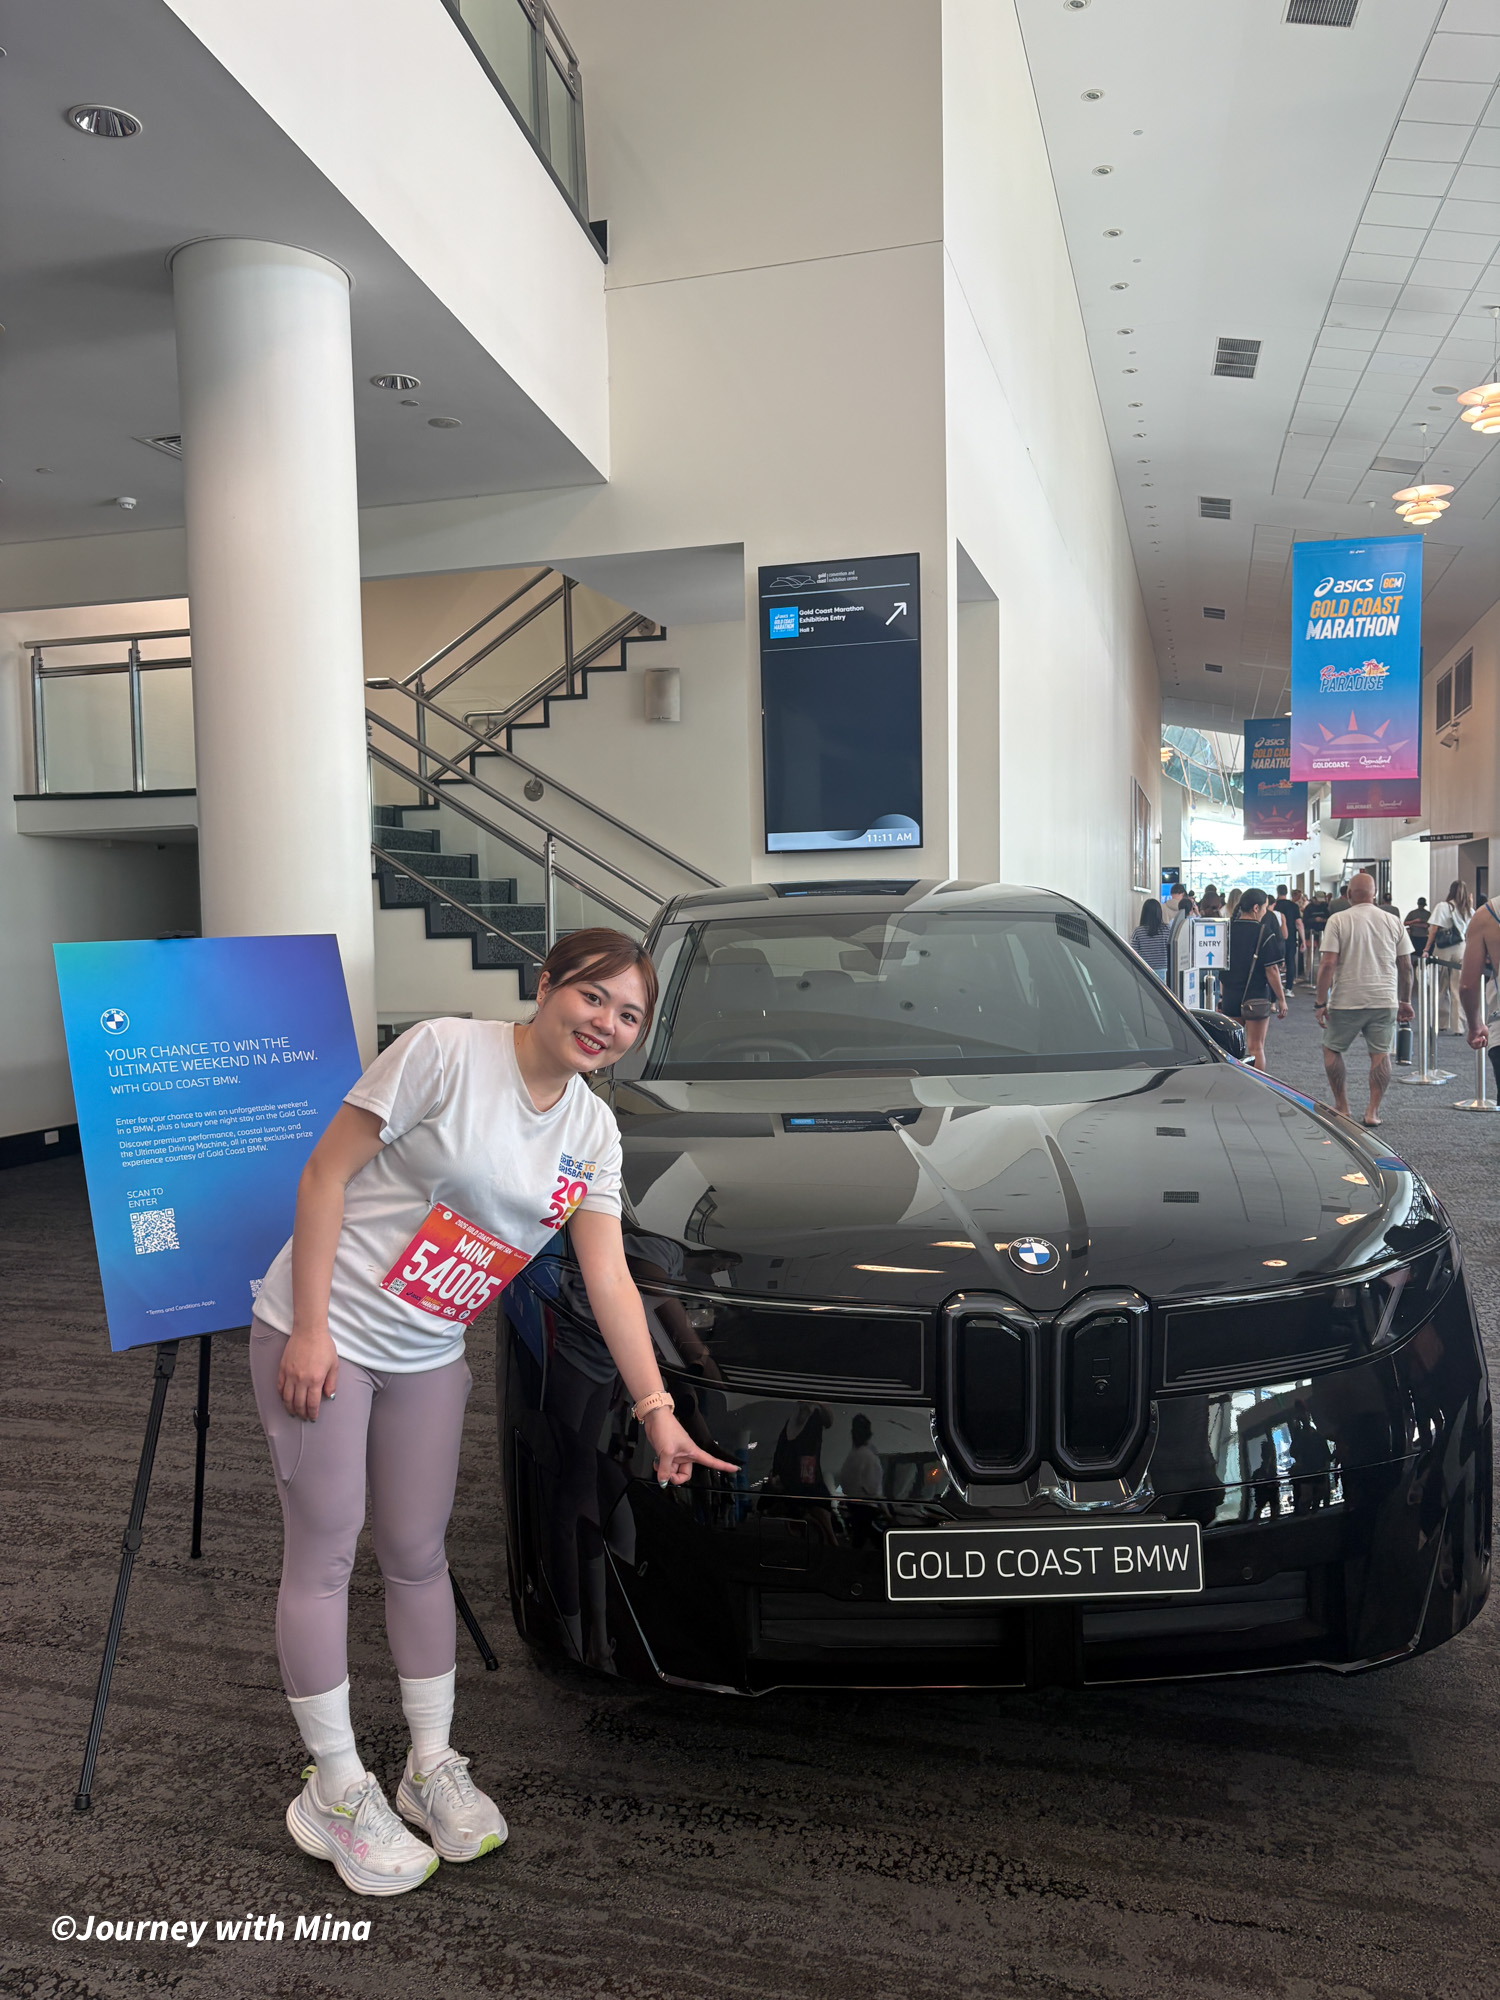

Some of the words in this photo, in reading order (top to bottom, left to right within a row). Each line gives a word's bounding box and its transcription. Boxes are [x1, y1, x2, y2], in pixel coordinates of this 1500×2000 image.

[1383, 577, 1402, 589] GCM
[1310, 599, 1350, 618] GOLD
[1352, 595, 1403, 616] COAST
[1306, 616, 1400, 640] MARATHON
[1320, 676, 1385, 693] PARADISE
[1251, 758, 1290, 769] MARATHO
[1252, 748, 1272, 758] GOLD
[1274, 748, 1290, 757] COA
[867, 834, 892, 842] 11:11
[897, 833, 912, 841] AM
[105, 1048, 147, 1061] YOUR
[150, 1043, 209, 1058] CHANCE
[210, 1041, 230, 1053] TO
[233, 1039, 259, 1051] WIN
[261, 1037, 290, 1049] THE
[108, 1061, 179, 1078] ULTIMATE
[180, 1055, 249, 1071] WEEKEND
[253, 1053, 267, 1065] IN
[270, 1053, 280, 1064] A
[283, 1050, 318, 1063] BMW.
[111, 1084, 140, 1094] WITH
[142, 1081, 173, 1092] GOLD
[176, 1077, 210, 1089] COAST
[213, 1076, 240, 1086] BMW.
[133, 1125, 156, 1134] BMW,
[158, 1123, 172, 1132] plus
[181, 1121, 202, 1129] luxury
[220, 1117, 238, 1125] night
[279, 1110, 295, 1118] Gold
[149, 1115, 166, 1124] your
[167, 1112, 193, 1121] chance
[230, 1104, 276, 1115] unforgettable
[277, 1100, 308, 1109] weekend
[120, 1140, 151, 1149] Discover
[154, 1136, 186, 1146] premium
[188, 1131, 236, 1142] performance,
[237, 1127, 262, 1136] coastal
[264, 1125, 286, 1133] luxury,
[135, 1147, 166, 1156] Ultimate
[168, 1143, 194, 1153] Driving
[196, 1140, 229, 1150] Machine,
[264, 1133, 294, 1142] exclusive
[296, 1130, 313, 1139] prize
[122, 1157, 163, 1168] experience
[165, 1154, 196, 1162] courtesy
[225, 1148, 245, 1156] Coast
[247, 1145, 268, 1153] BMW.
[584, 1164, 595, 1172] TO
[127, 1189, 150, 1199] SCAN
[129, 1198, 157, 1208] ENTER
[551, 1175, 588, 1207] 20
[466, 1224, 478, 1236] GOLD
[477, 1230, 491, 1243] COAST
[489, 1240, 505, 1252] AIRPORT
[453, 1234, 496, 1269] MINA
[402, 1240, 502, 1309] 54005
[175, 1302, 200, 1310] Conditions
[897, 1550, 986, 1579] GOLD
[996, 1547, 1103, 1577] COAST
[1113, 1543, 1190, 1574] BMW
[328, 1820, 370, 1860] HOKA
